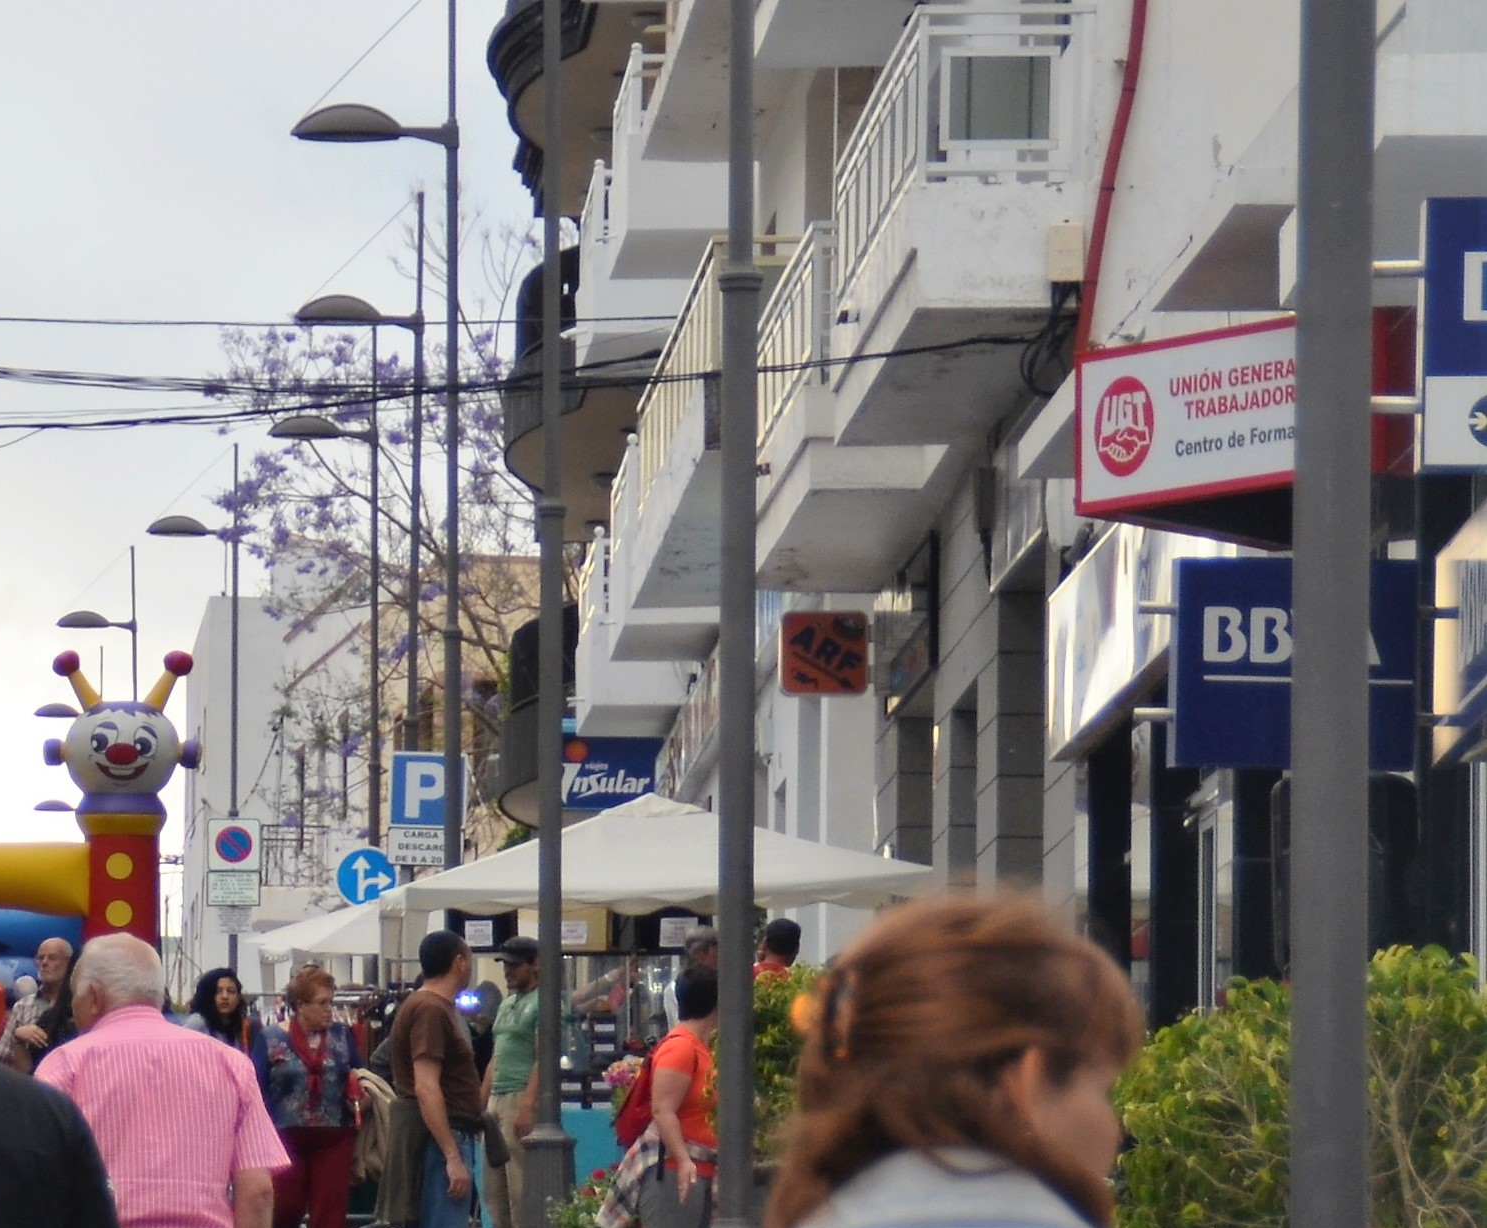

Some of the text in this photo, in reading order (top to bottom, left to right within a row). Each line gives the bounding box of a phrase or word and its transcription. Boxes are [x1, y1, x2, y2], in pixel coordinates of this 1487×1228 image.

[1168, 358, 1295, 397] UNIÓN GENERA
[1101, 390, 1148, 430] UGT
[1184, 384, 1295, 420] TRABAJADOR
[1175, 423, 1295, 457] Centro de Forma
[791, 626, 863, 673] ARF
[405, 761, 445, 818] P
[561, 763, 651, 803] Insular
[403, 830, 439, 839] CARGA
[395, 855, 408, 863] DE
[420, 855, 428, 864] A
